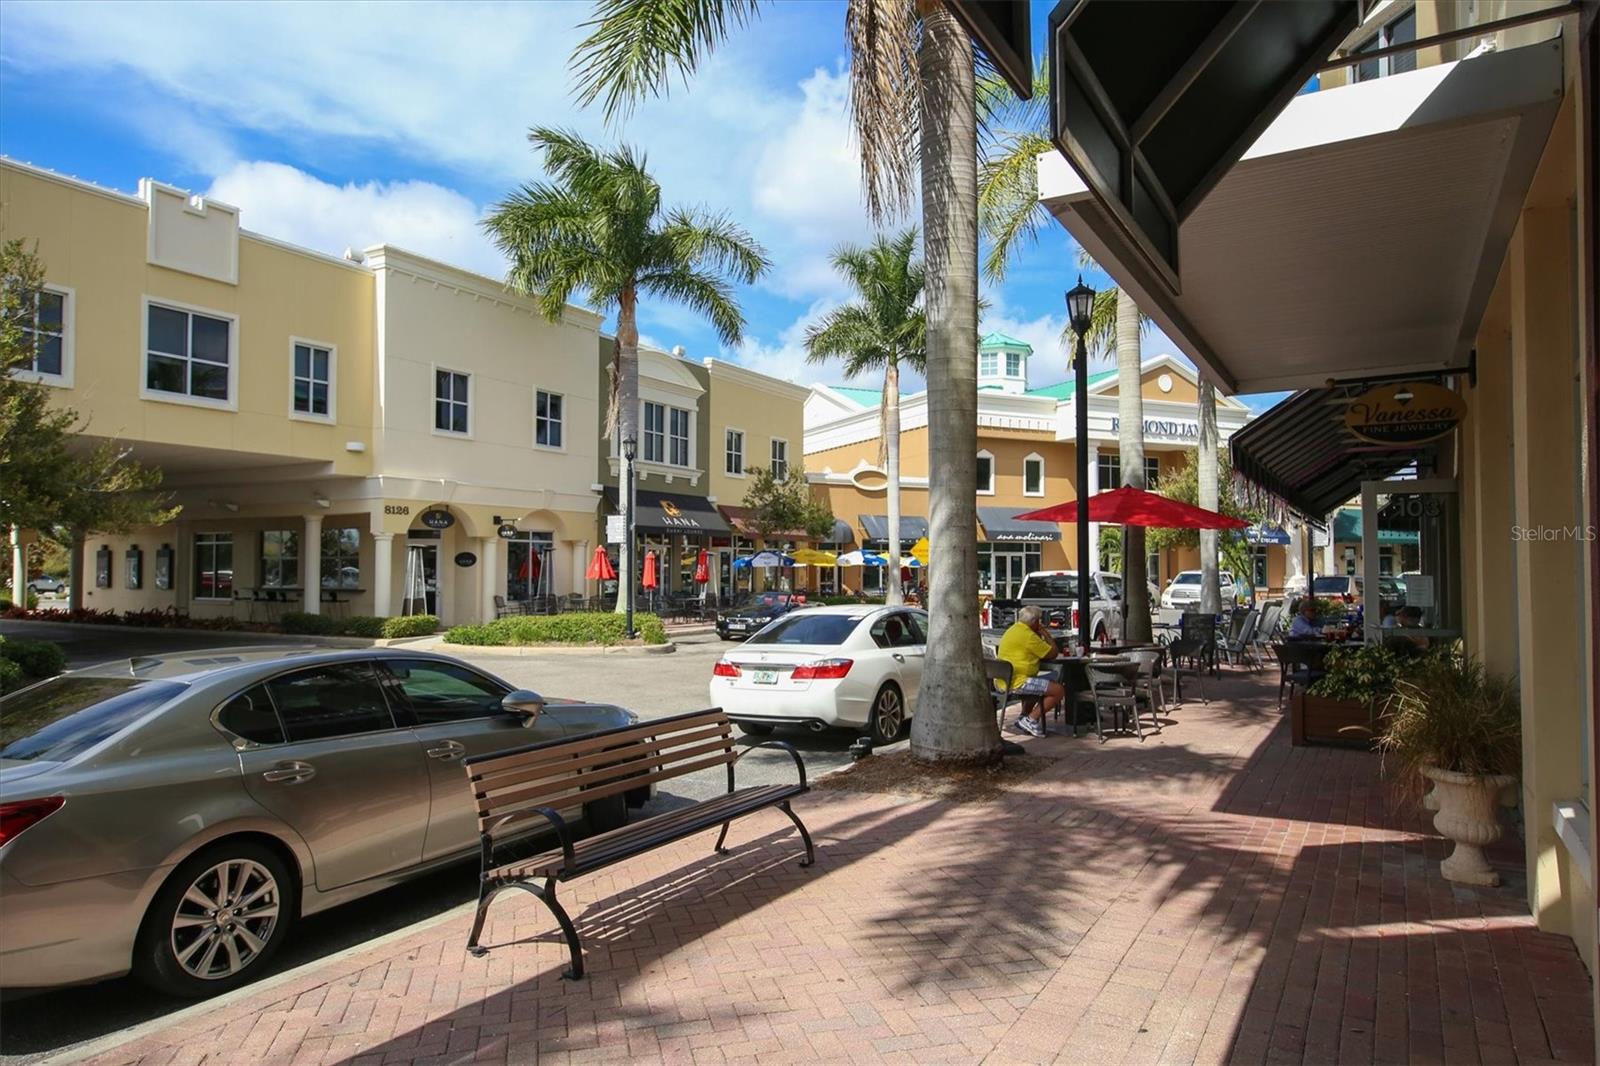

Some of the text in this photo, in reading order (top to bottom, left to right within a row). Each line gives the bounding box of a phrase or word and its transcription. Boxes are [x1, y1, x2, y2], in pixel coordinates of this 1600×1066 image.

[1351, 403, 1453, 423] Vanessa
[1112, 417, 1178, 435] ROND
[1361, 421, 1448, 433] FINE JEWELRY
[662, 516, 700, 527] HANA
[1015, 532, 1053, 541] molinari
